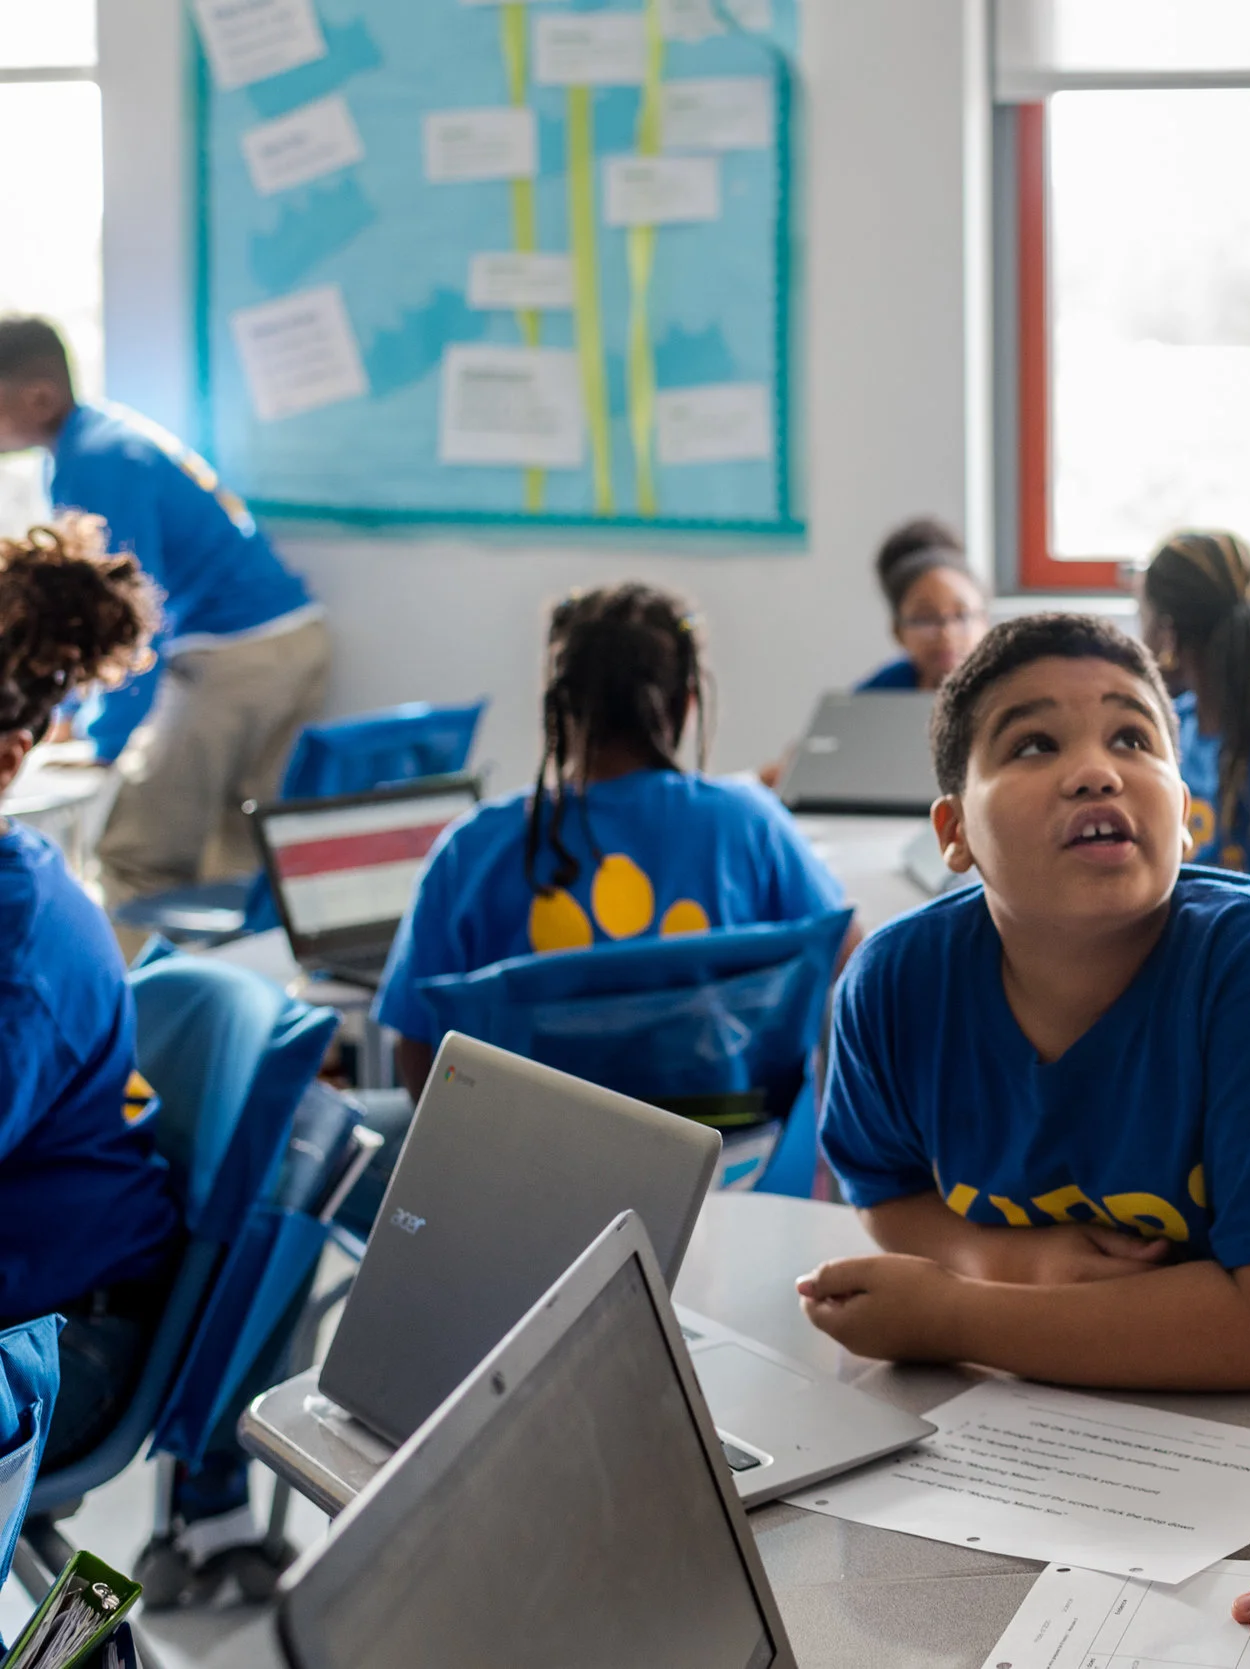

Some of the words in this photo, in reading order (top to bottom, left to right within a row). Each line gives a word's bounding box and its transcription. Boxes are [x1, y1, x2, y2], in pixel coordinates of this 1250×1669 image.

[391, 1207, 427, 1235] acer
[1082, 1431, 1099, 1439] THE
[1102, 1436, 1151, 1451] MODELING
[1153, 1447, 1191, 1459] MATTER
[1058, 1468, 1076, 1476] and
[1077, 1473, 1098, 1482] Click
[1122, 1484, 1160, 1495] account
[1103, 1507, 1124, 1516] click
[1143, 1516, 1166, 1525] drop
[1167, 1521, 1195, 1531] down
